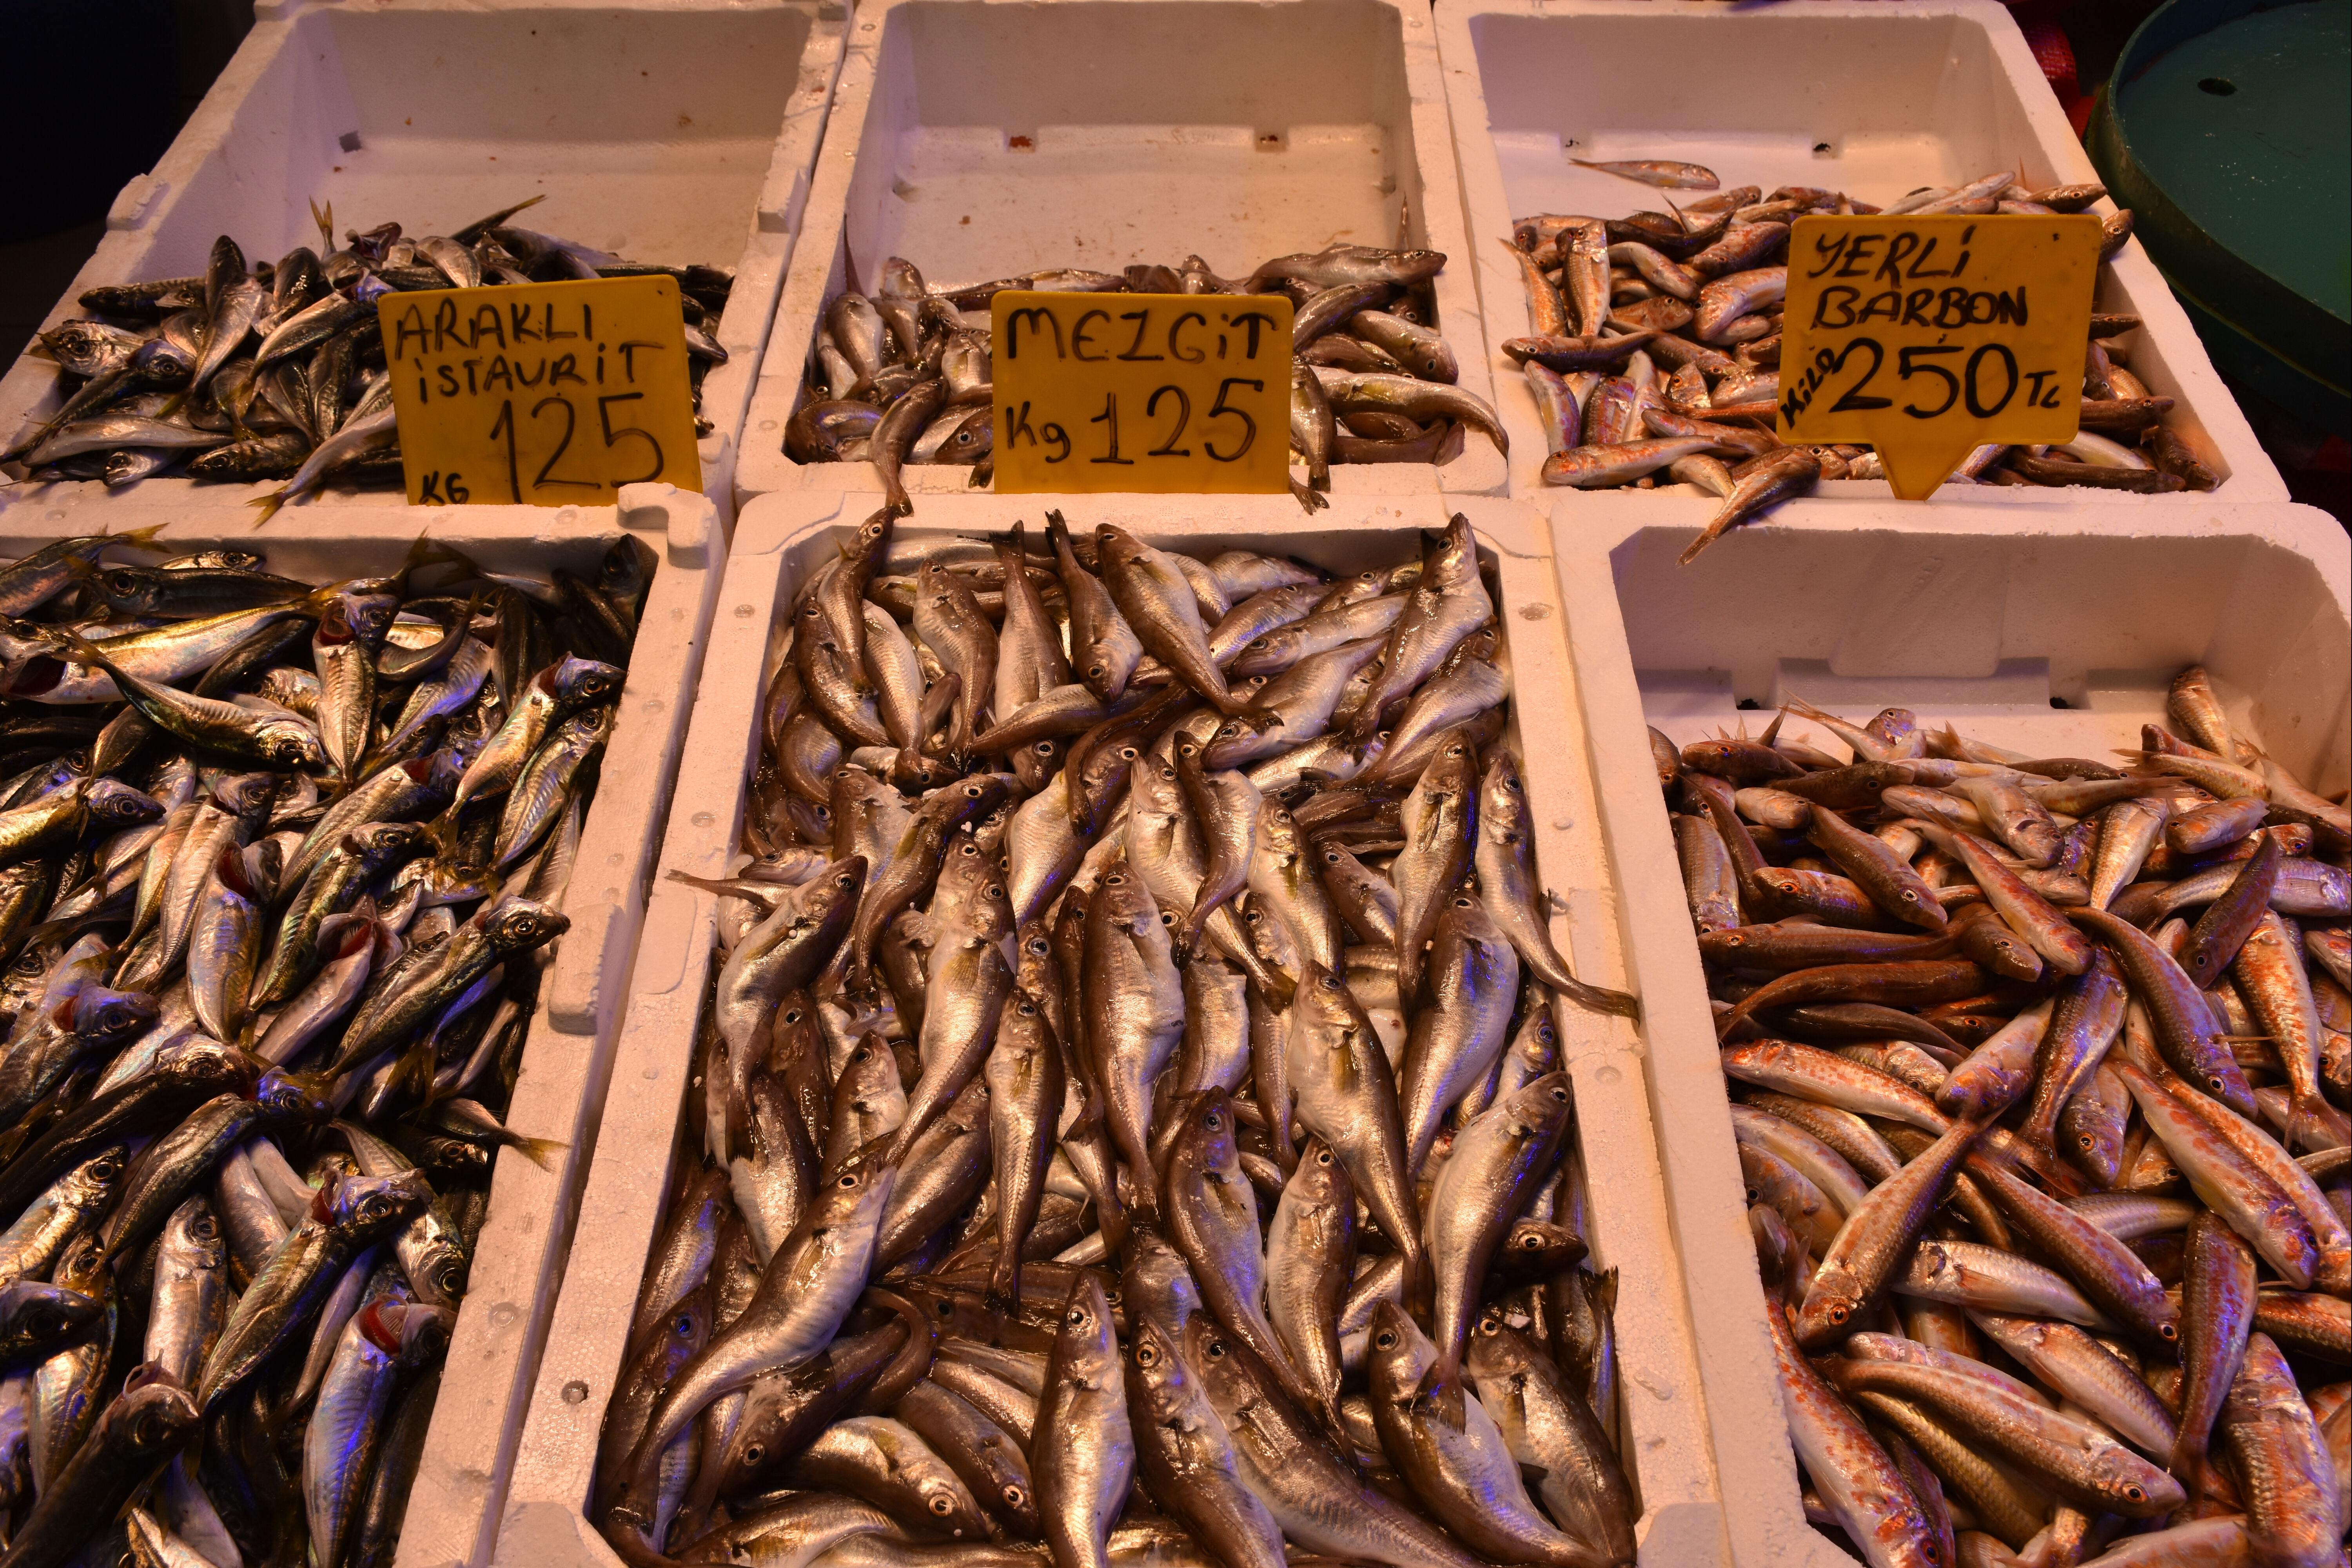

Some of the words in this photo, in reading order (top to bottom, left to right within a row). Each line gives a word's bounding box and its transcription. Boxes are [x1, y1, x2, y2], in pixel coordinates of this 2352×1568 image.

[395, 297, 592, 361] ARAKLI
[1810, 285, 2028, 330] BARBON
[1829, 337, 2019, 419] 250
[419, 471, 470, 505] KG
[489, 393, 664, 504] 125
[1090, 378, 1264, 465] 125
